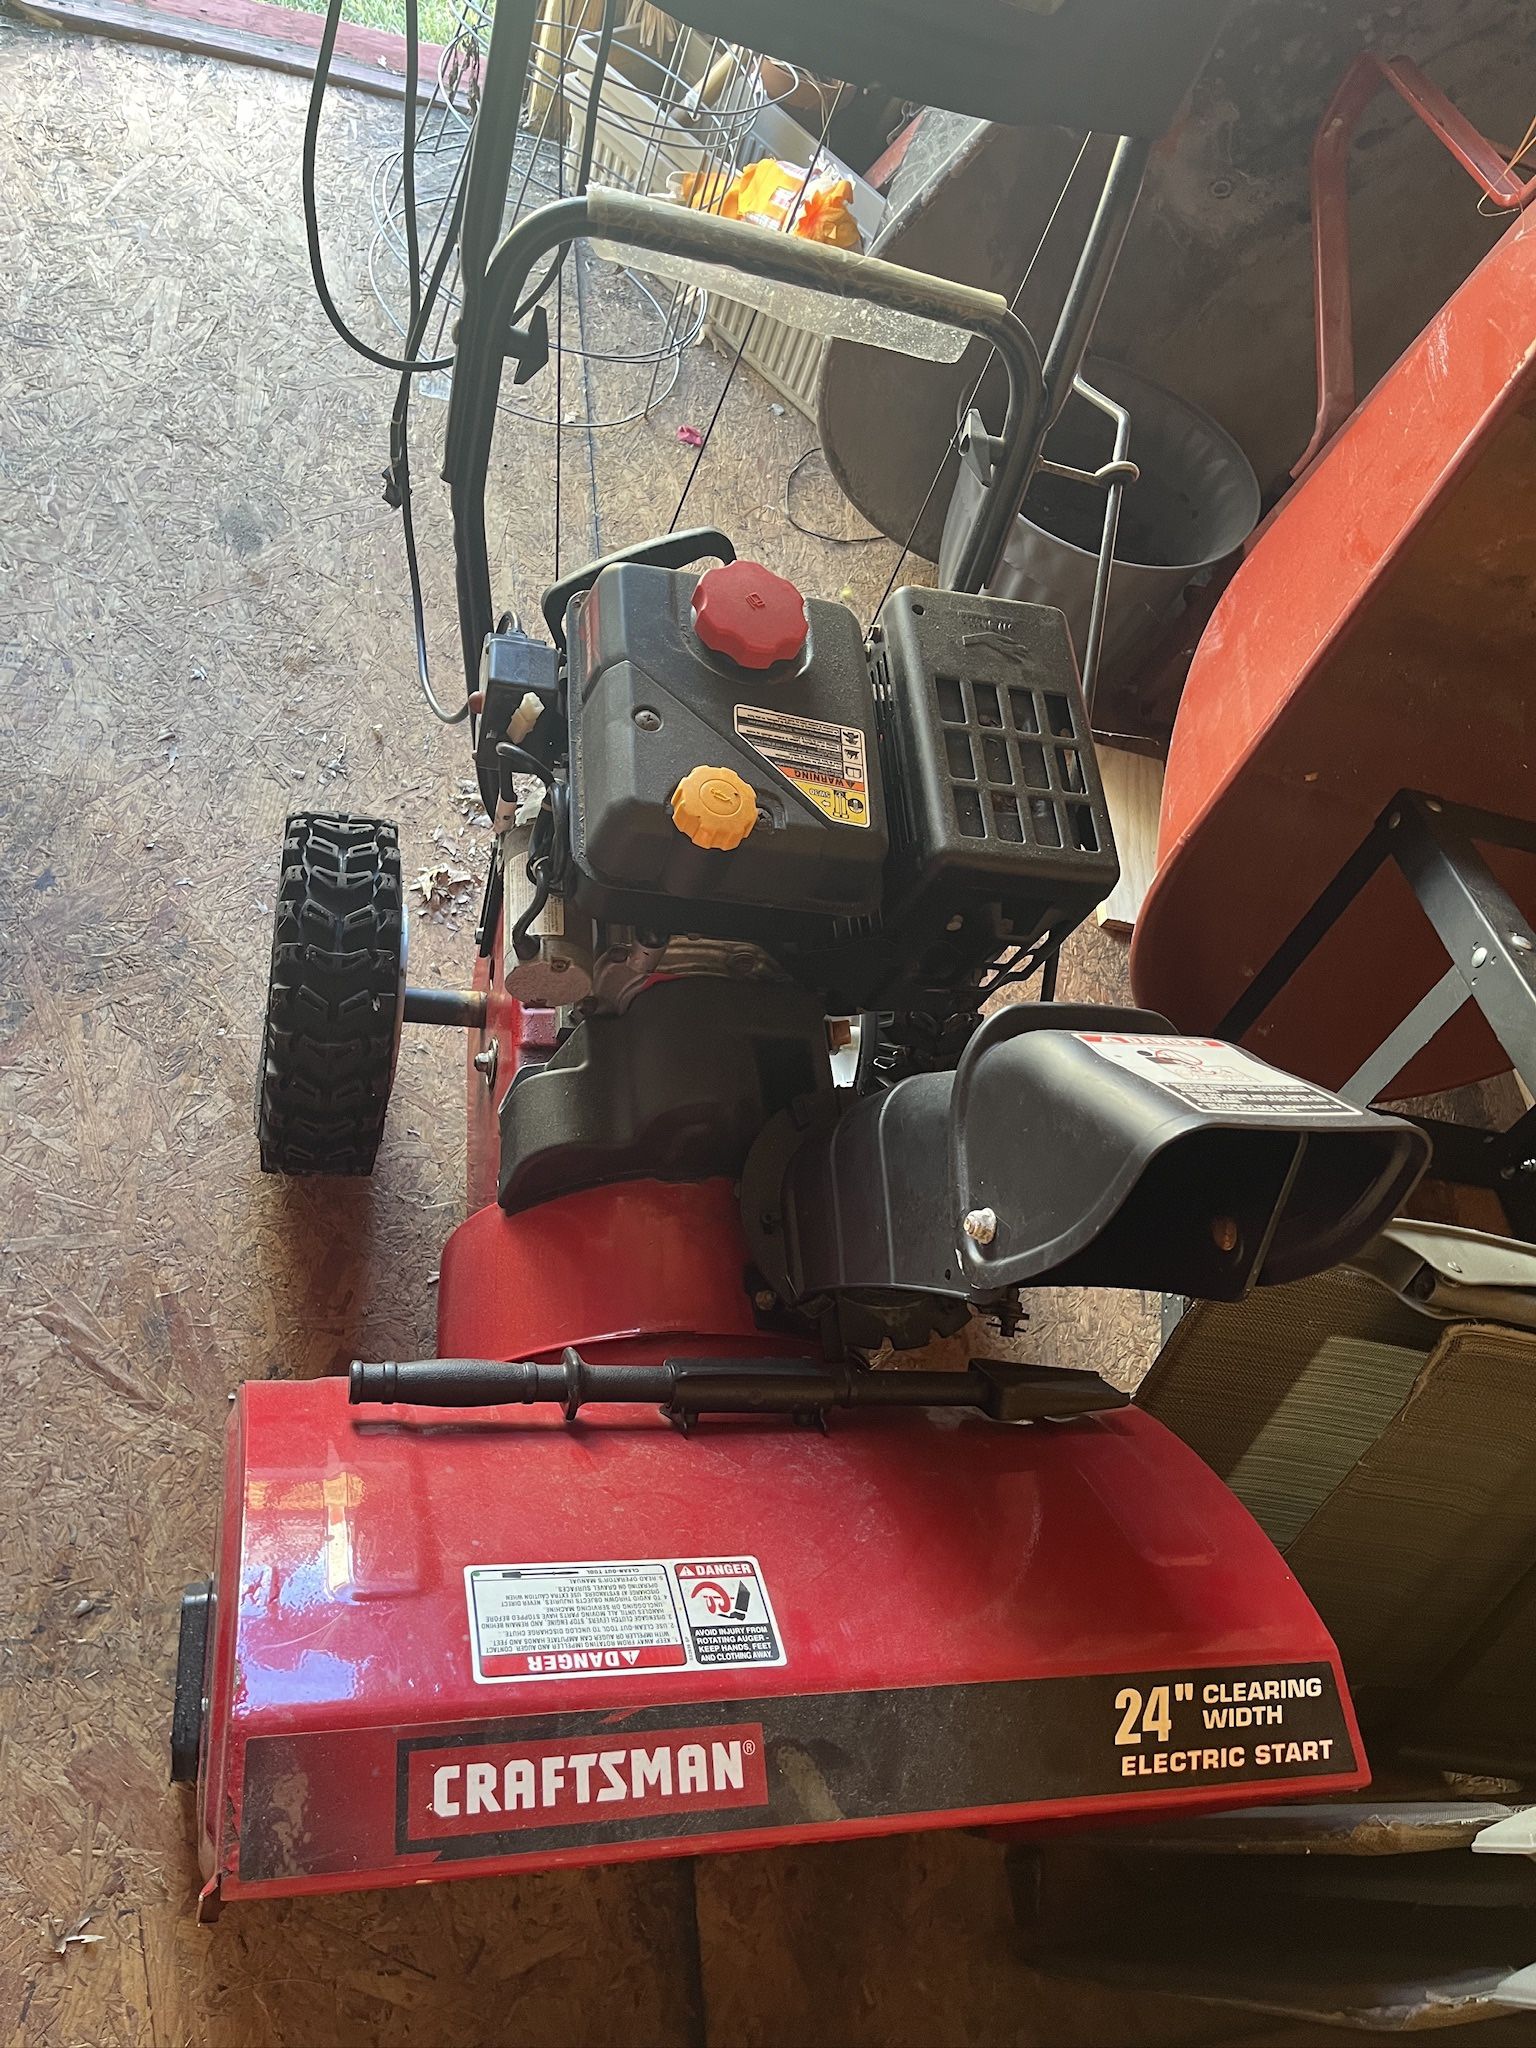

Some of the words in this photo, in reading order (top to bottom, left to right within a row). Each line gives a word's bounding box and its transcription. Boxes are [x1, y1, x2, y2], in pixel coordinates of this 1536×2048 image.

[794, 770, 844, 787] WARNING
[696, 1564, 752, 1575] DANGER
[695, 1628, 719, 1636] AVOID
[697, 1636, 736, 1645] ROTATING
[737, 1635, 763, 1643] AUGER
[698, 1645, 720, 1653] KEEP
[717, 1652, 751, 1660] CLOTHING
[527, 1651, 620, 1671] DANGER
[1114, 1683, 1194, 1746] 24"
[1202, 1677, 1322, 1704] CLEARING
[1202, 1704, 1283, 1730] WIDTH
[1121, 1746, 1246, 1777] ELECTRIC
[1254, 1739, 1334, 1766] START
